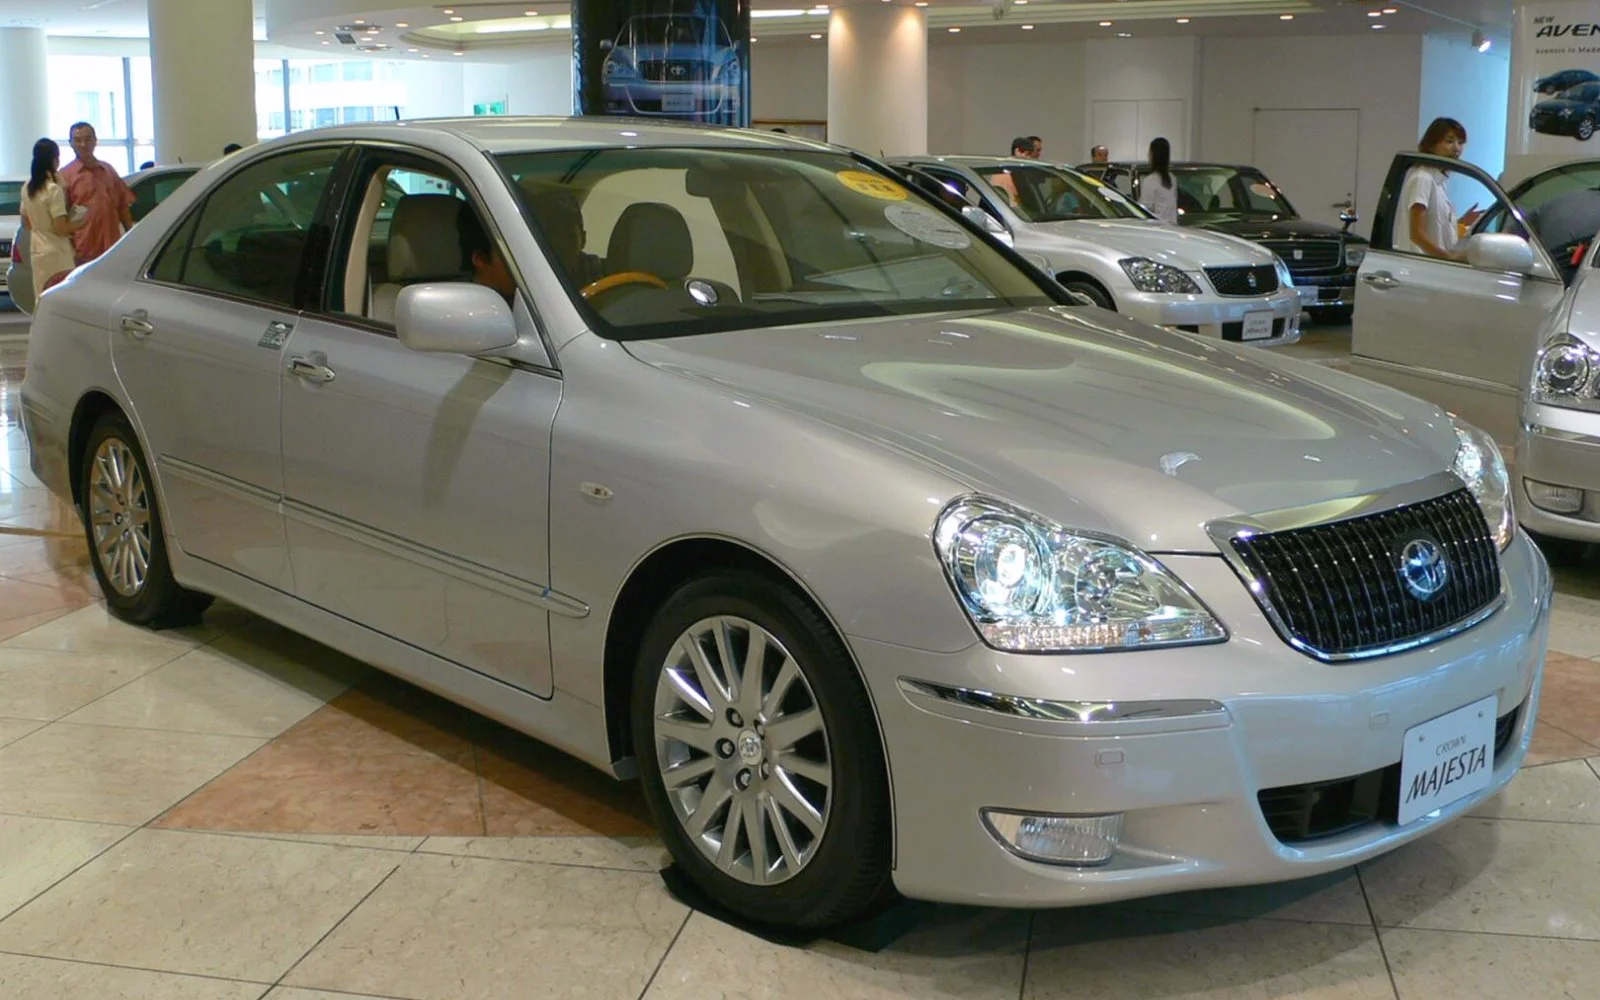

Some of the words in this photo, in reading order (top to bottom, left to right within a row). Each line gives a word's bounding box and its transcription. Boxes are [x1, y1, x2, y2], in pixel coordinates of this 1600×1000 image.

[1533, 16, 1555, 24] NEW
[1435, 735, 1466, 756] CROWN
[1405, 744, 1486, 804] MAJESTA
